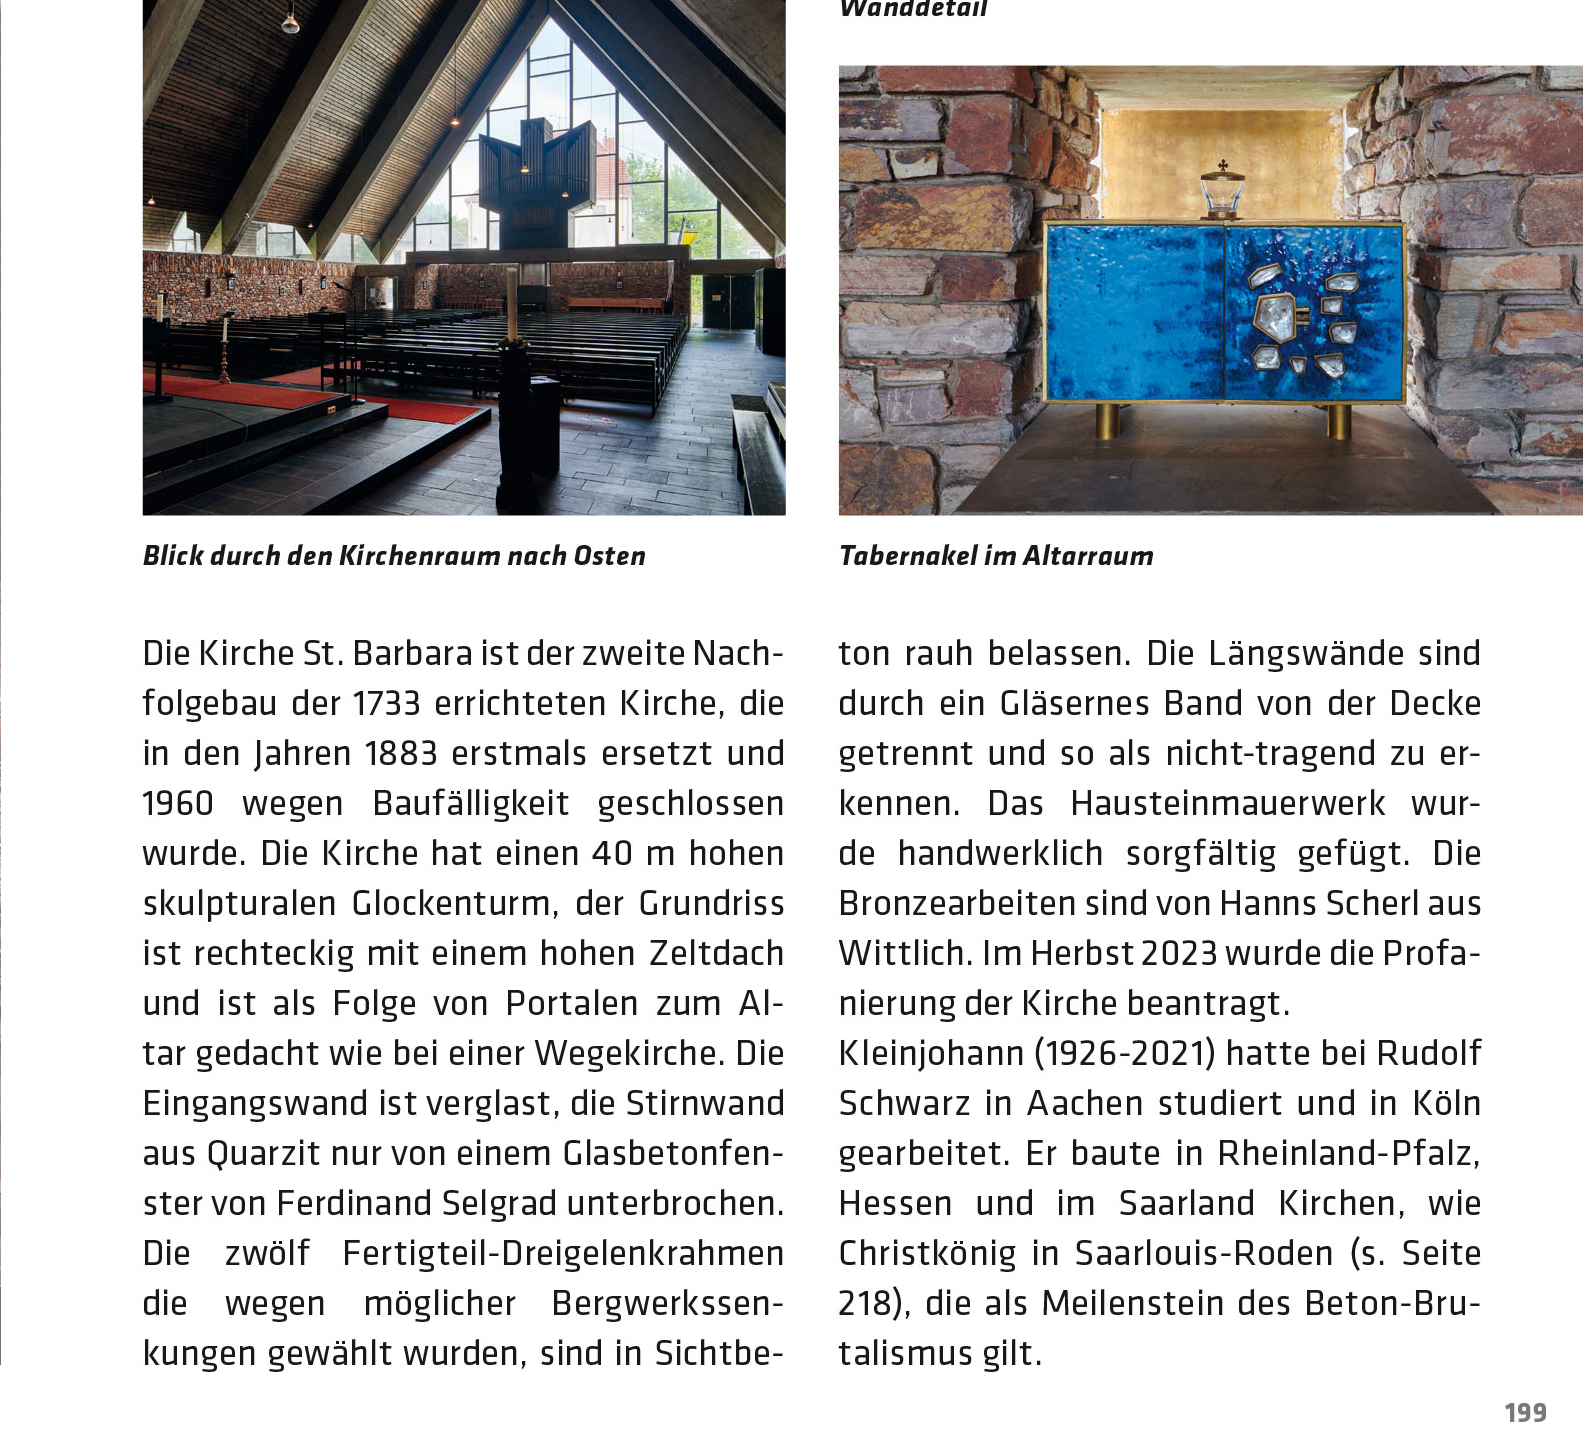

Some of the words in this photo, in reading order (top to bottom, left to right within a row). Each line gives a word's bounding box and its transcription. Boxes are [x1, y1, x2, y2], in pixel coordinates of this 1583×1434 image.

[142, 543, 205, 566] Blick
[210, 543, 281, 566] durch
[287, 543, 333, 566] den
[339, 543, 501, 566] Kirchenraum
[507, 543, 567, 566] nach
[574, 544, 646, 566] Osten
[840, 543, 979, 566] Tabernakel
[984, 543, 1017, 566] im
[1021, 543, 1154, 566] Altarraum
[144, 638, 190, 666] Die
[200, 638, 294, 666] Kirche
[303, 639, 343, 666] St.
[354, 638, 472, 666] Barbara
[482, 638, 519, 666] ist
[527, 638, 575, 666] der
[582, 638, 685, 666] zweite
[694, 638, 784, 666] Nach-
[838, 641, 889, 666] ton
[906, 638, 972, 666] rauh
[989, 638, 1130, 666] belassen.
[1148, 638, 1194, 666] Die
[1210, 638, 1404, 673] Längswände
[1419, 638, 1480, 666] sind
[142, 687, 276, 723] folgebau
[292, 688, 341, 716] der
[353, 689, 420, 716] 1733
[435, 688, 605, 716] errichteten
[621, 688, 724, 720] Kirche,
[740, 688, 784, 716] die
[839, 688, 923, 716] durch
[940, 688, 984, 716] ein
[1001, 688, 1149, 716] Gläsernes
[1165, 688, 1242, 716] Band
[1256, 695, 1311, 716] von
[1328, 688, 1376, 716] der
[1391, 688, 1481, 716] Decke
[142, 789, 213, 816] 1960
[242, 795, 342, 823] wegen
[374, 787, 569, 823] Baufälligkeit
[598, 788, 783, 823] geschlossen
[142, 838, 245, 866] wurde.
[262, 838, 308, 866] Die
[323, 838, 418, 866] Kirche
[432, 838, 482, 866] hat
[496, 838, 578, 866] einen
[591, 839, 632, 866] 40
[647, 845, 674, 866] m
[690, 838, 783, 866] hohen
[839, 838, 875, 866] de
[899, 838, 1102, 866] handwerklich
[1127, 837, 1276, 873] sorgfältig
[1298, 837, 1409, 873] gefügt.
[1434, 838, 1481, 866] Die
[144, 888, 335, 923] skulpturalen
[353, 888, 558, 920] Glockenturm,
[576, 888, 624, 916] der
[640, 888, 784, 916] Grundriss
[840, 888, 1075, 916] Bronzearbeiten
[1086, 888, 1147, 916] sind
[1155, 895, 1210, 916] von
[1221, 889, 1316, 916] Hanns
[1326, 888, 1418, 916] Scherl
[1428, 895, 1481, 916] aus
[144, 988, 199, 1016] und
[219, 988, 256, 1016] ist
[273, 988, 315, 1016] als
[334, 988, 416, 1023] Folge
[432, 995, 487, 1016] von
[507, 988, 637, 1016] Portalen
[656, 995, 720, 1016] zum
[738, 988, 784, 1016] Al-
[840, 988, 956, 1023] nierung
[965, 988, 1014, 1016] der
[1023, 988, 1117, 1016] Kirche
[1128, 988, 1289, 1023] beantragt.
[142, 1041, 186, 1066] tar
[196, 1038, 319, 1073] gedacht
[329, 1038, 382, 1066] wie
[394, 1038, 437, 1066] bei
[449, 1038, 525, 1066] einer
[534, 1038, 724, 1073] Wegekirche.
[737, 1038, 784, 1066] Die
[840, 1038, 1023, 1073] Kleinjohann
[1035, 1035, 1215, 1072] (1926-2021)
[1227, 1038, 1310, 1066] hatte
[1322, 1038, 1365, 1066] bei
[1378, 1037, 1483, 1066] Rudolf
[144, 1088, 367, 1123] Eingangswand
[380, 1088, 417, 1116] ist
[425, 1088, 559, 1123] verglast,
[571, 1088, 615, 1116] die
[626, 1088, 784, 1116] Stirnwand
[839, 1088, 970, 1116] Schwarz
[986, 1088, 1011, 1116] in
[1026, 1088, 1142, 1116] Aachen
[1159, 1088, 1282, 1116] studiert
[1298, 1088, 1355, 1116] und
[1371, 1088, 1396, 1116] in
[1414, 1088, 1480, 1116] Köln
[144, 1191, 203, 1216] ster
[210, 1195, 265, 1216] von
[278, 1188, 431, 1216] Ferdinand
[442, 1188, 556, 1223] Selgrad
[568, 1188, 783, 1216] unterbrochen.
[840, 1189, 951, 1216] Hessen
[977, 1188, 1033, 1216] und
[1058, 1188, 1094, 1216] im
[1119, 1188, 1254, 1216] Saarland
[1280, 1188, 1404, 1220] Kirchen,
[1428, 1188, 1481, 1216] wie
[144, 1238, 190, 1266] Die
[225, 1237, 311, 1266] zwölf
[344, 1238, 783, 1273] Fertigteil-Dreigelenkrahmen
[840, 1238, 1016, 1273] Christkönig
[1033, 1238, 1058, 1266] in
[1075, 1238, 1332, 1266] Saarlouis-Roden
[1351, 1235, 1384, 1272] (s.
[1402, 1238, 1481, 1266] Seite
[838, 1285, 910, 1322] 218),
[926, 1288, 971, 1316] die
[985, 1288, 1027, 1316] als
[1043, 1288, 1223, 1316] Meilenstein
[1238, 1288, 1290, 1316] des
[1306, 1289, 1481, 1316] Beton-Bru-
[144, 1338, 255, 1373] kungen
[268, 1338, 392, 1373] gewählt
[403, 1338, 526, 1370] wurden,
[541, 1338, 602, 1366] sind
[616, 1338, 641, 1366] in
[655, 1338, 784, 1366] Sichtbe-
[838, 1338, 972, 1366] talismus
[983, 1338, 1041, 1373] gilt.
[1504, 1402, 1547, 1423] 199
